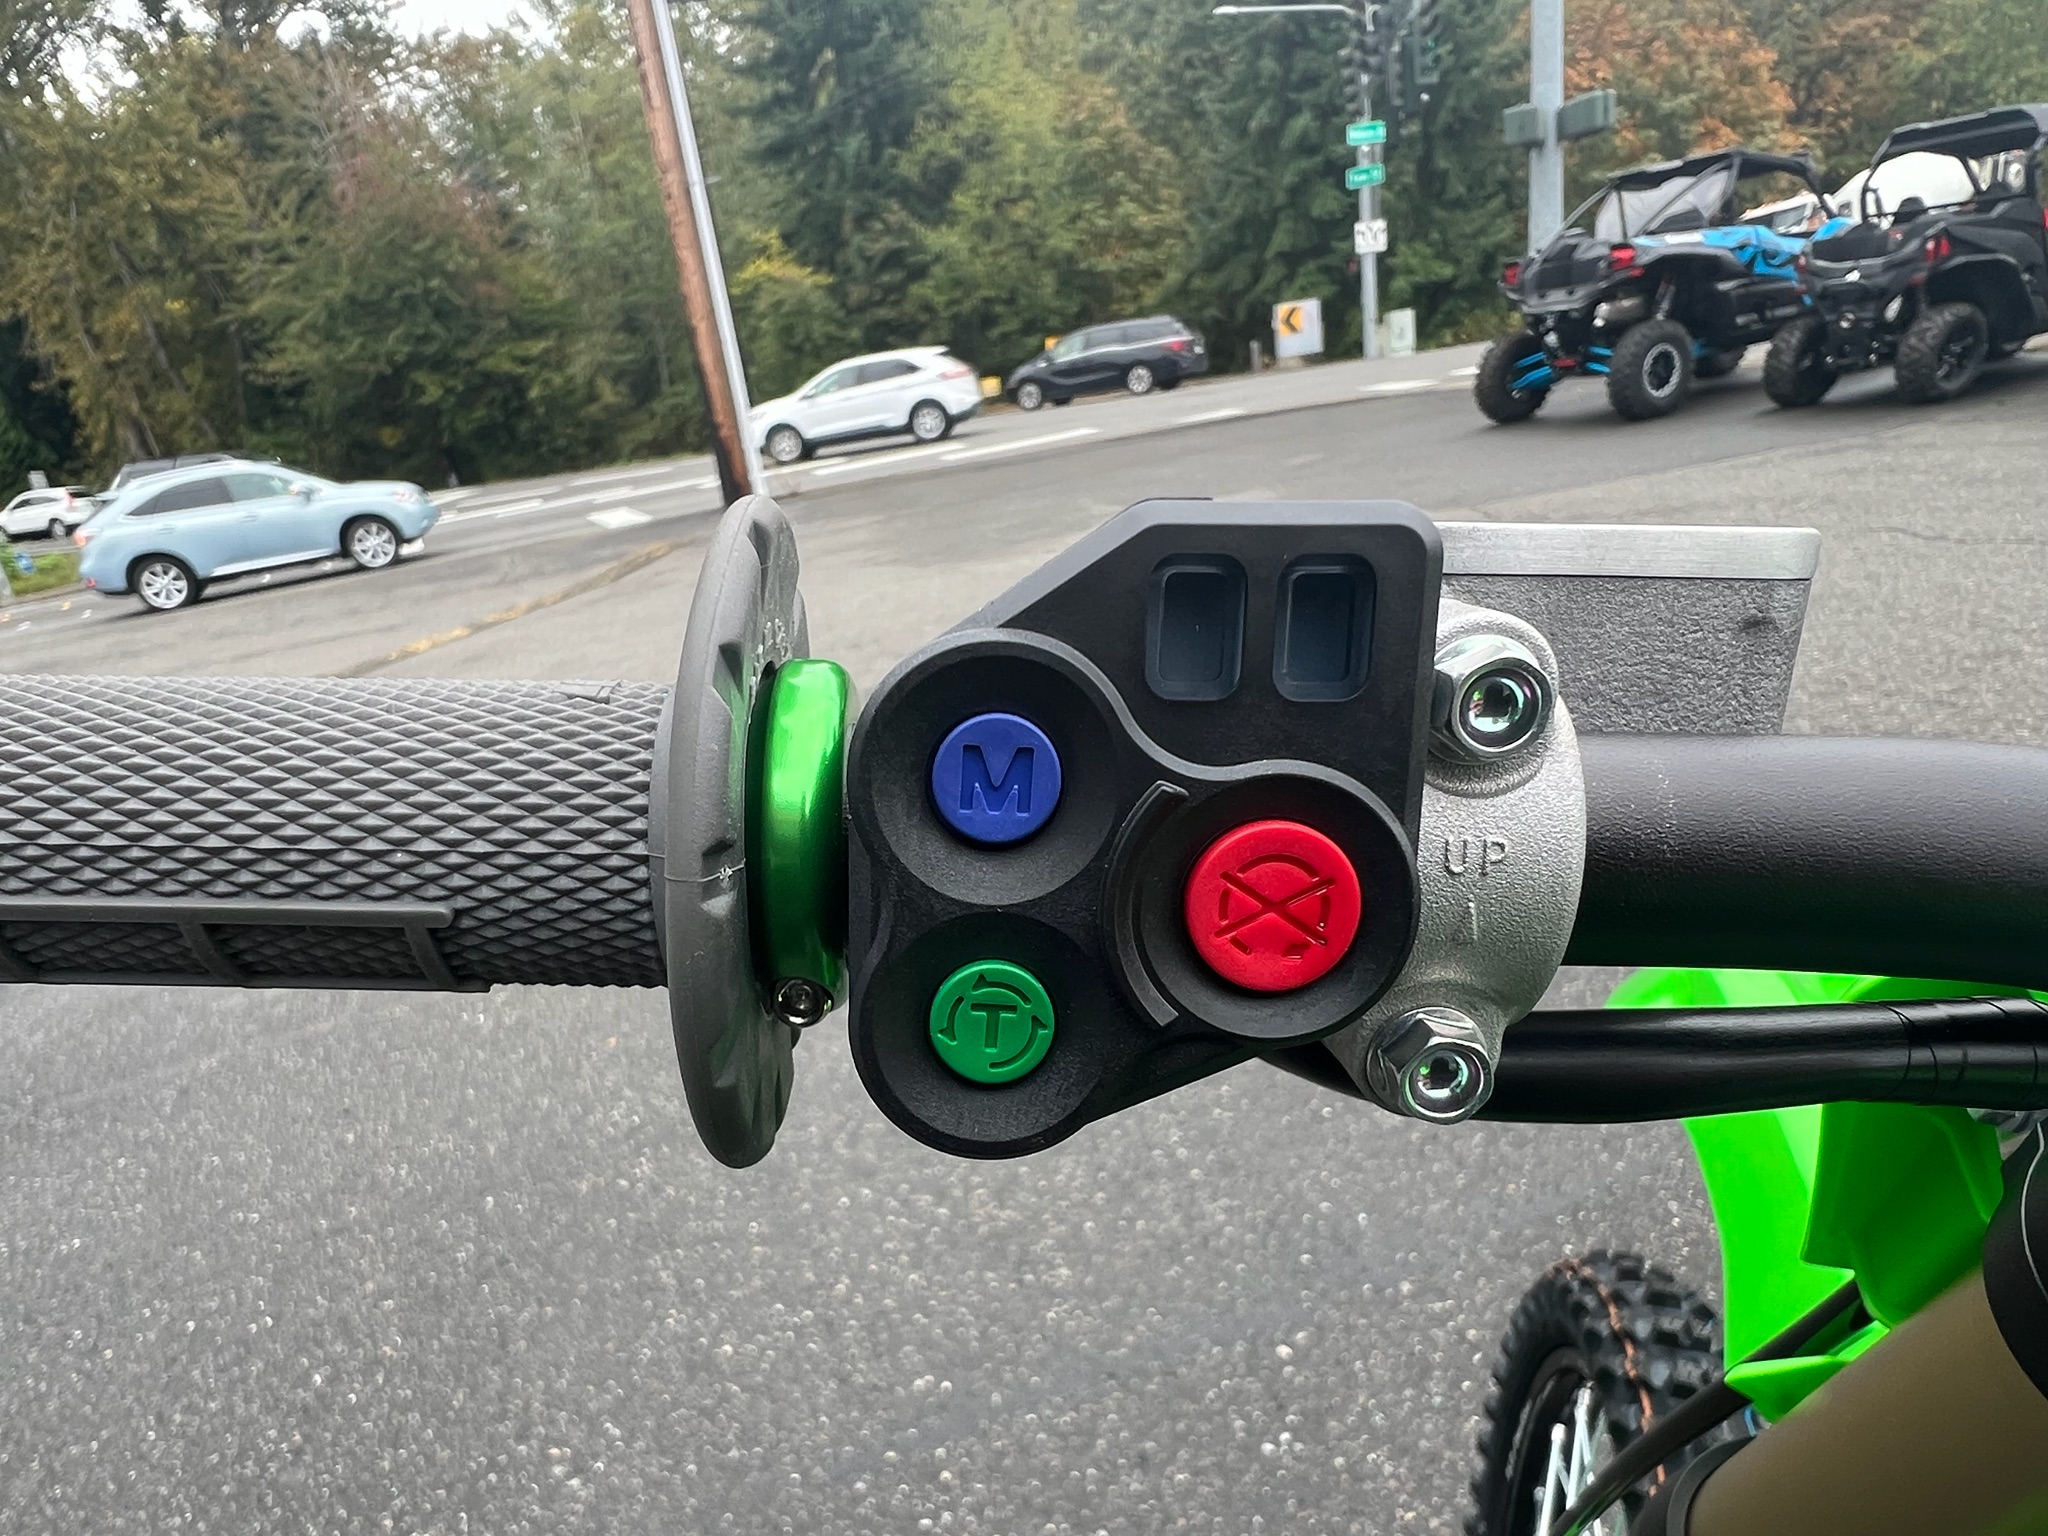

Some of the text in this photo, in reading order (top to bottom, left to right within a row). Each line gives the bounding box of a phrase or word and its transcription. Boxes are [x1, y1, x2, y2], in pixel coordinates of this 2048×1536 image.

[958, 743, 1037, 816] M
[1443, 836, 1509, 877] UP
[968, 1002, 1018, 1050] T
